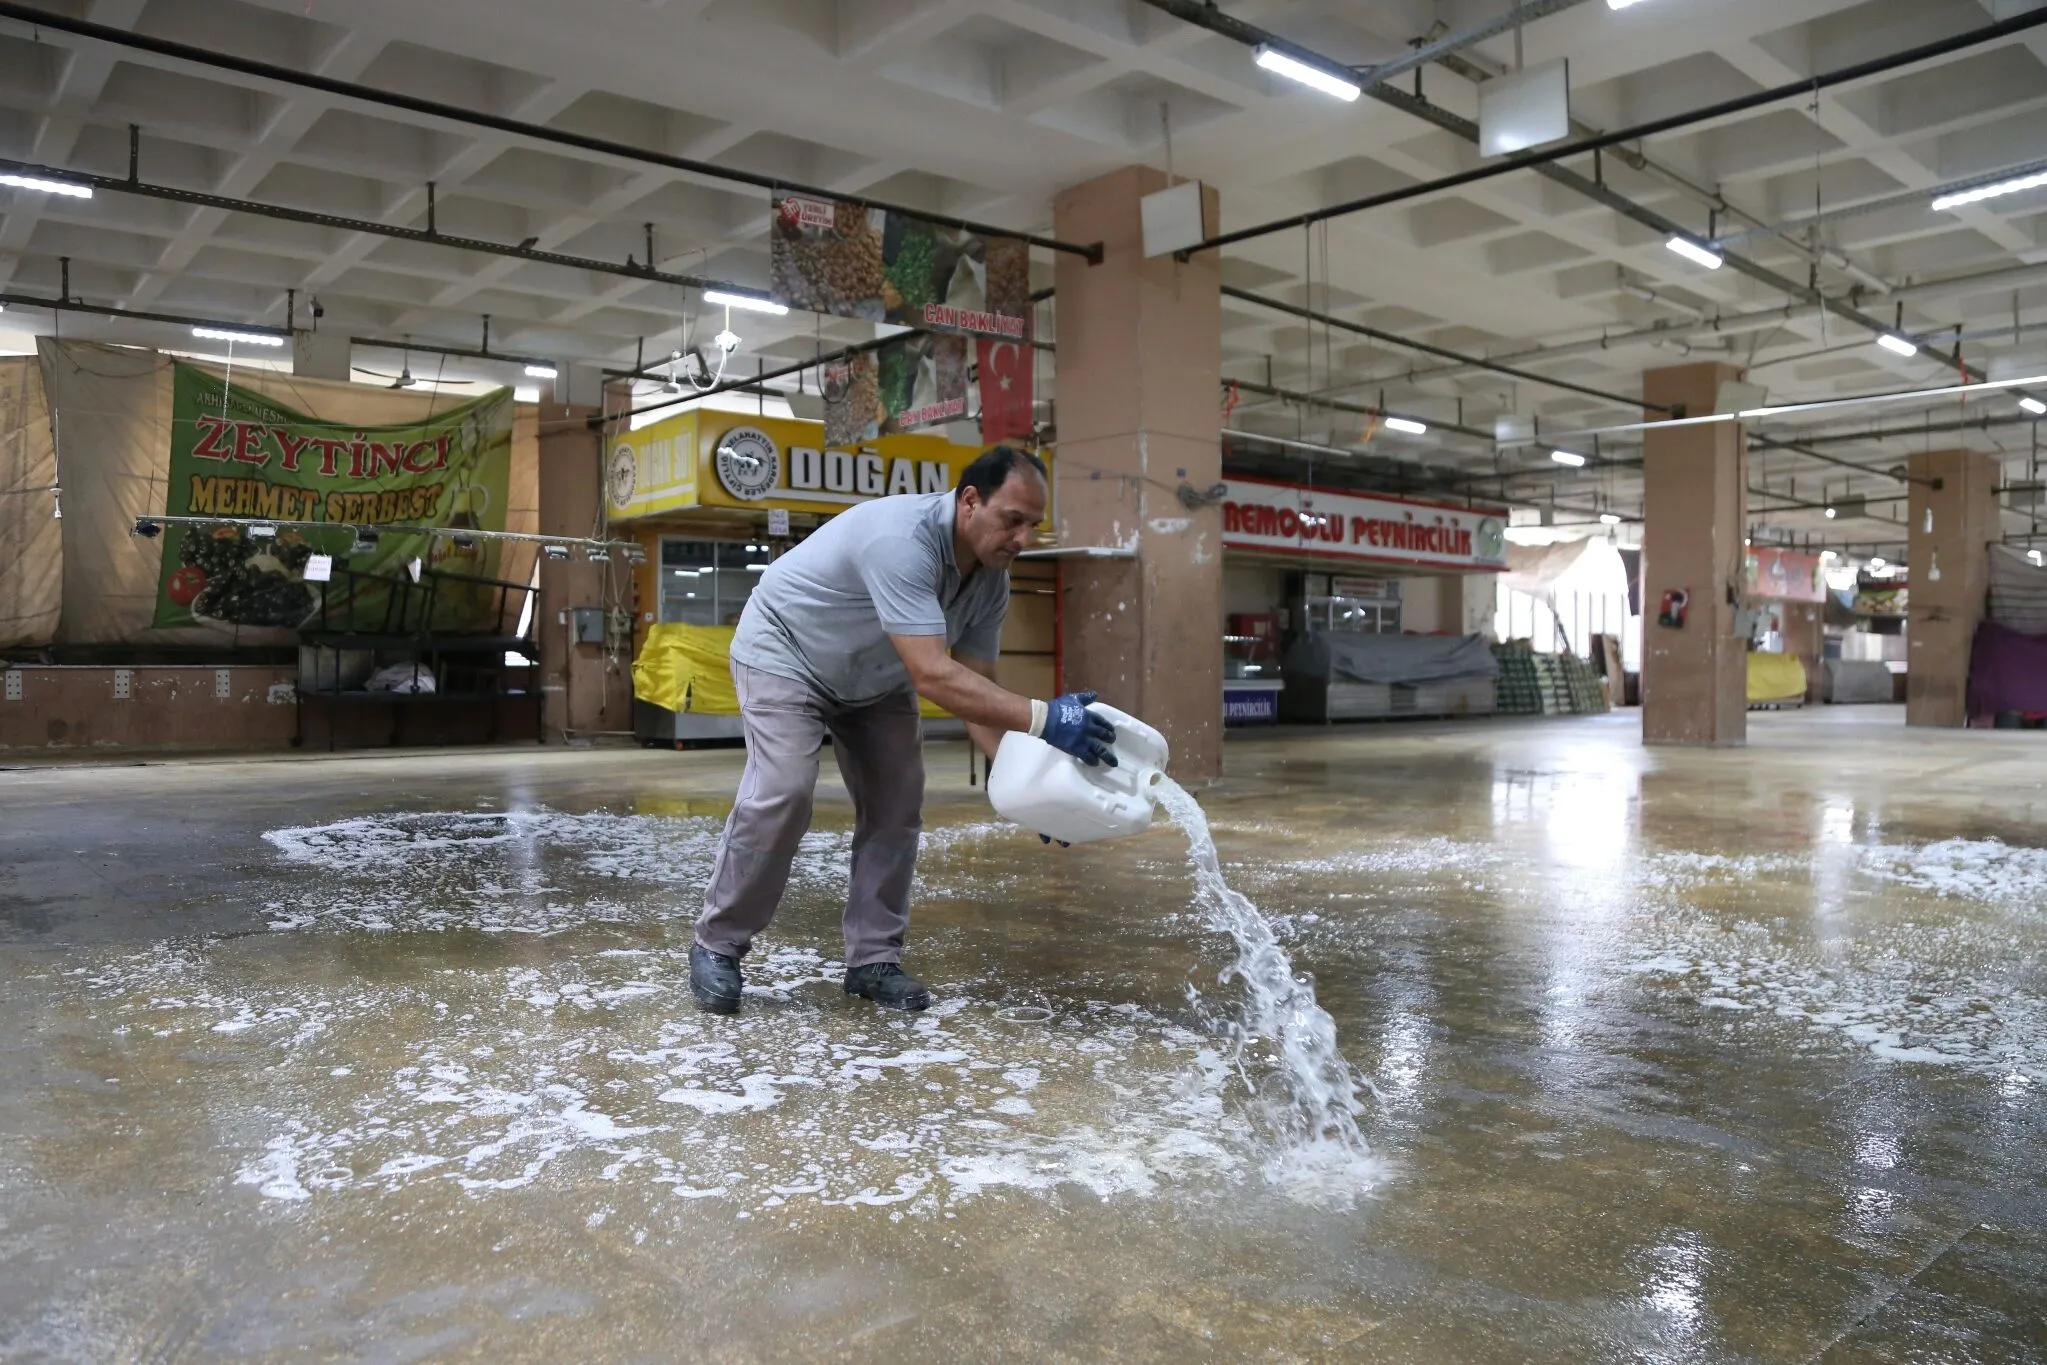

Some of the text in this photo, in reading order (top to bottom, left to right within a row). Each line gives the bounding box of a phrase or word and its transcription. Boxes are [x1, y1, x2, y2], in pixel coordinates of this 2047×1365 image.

[924, 303, 955, 327] CAN
[191, 413, 450, 478] ZEYTİNCİ
[790, 446, 949, 496] DOĞAN
[188, 474, 444, 525] MEHMET SERBEST
[1350, 510, 1473, 556] PEYNİRCİLİK
